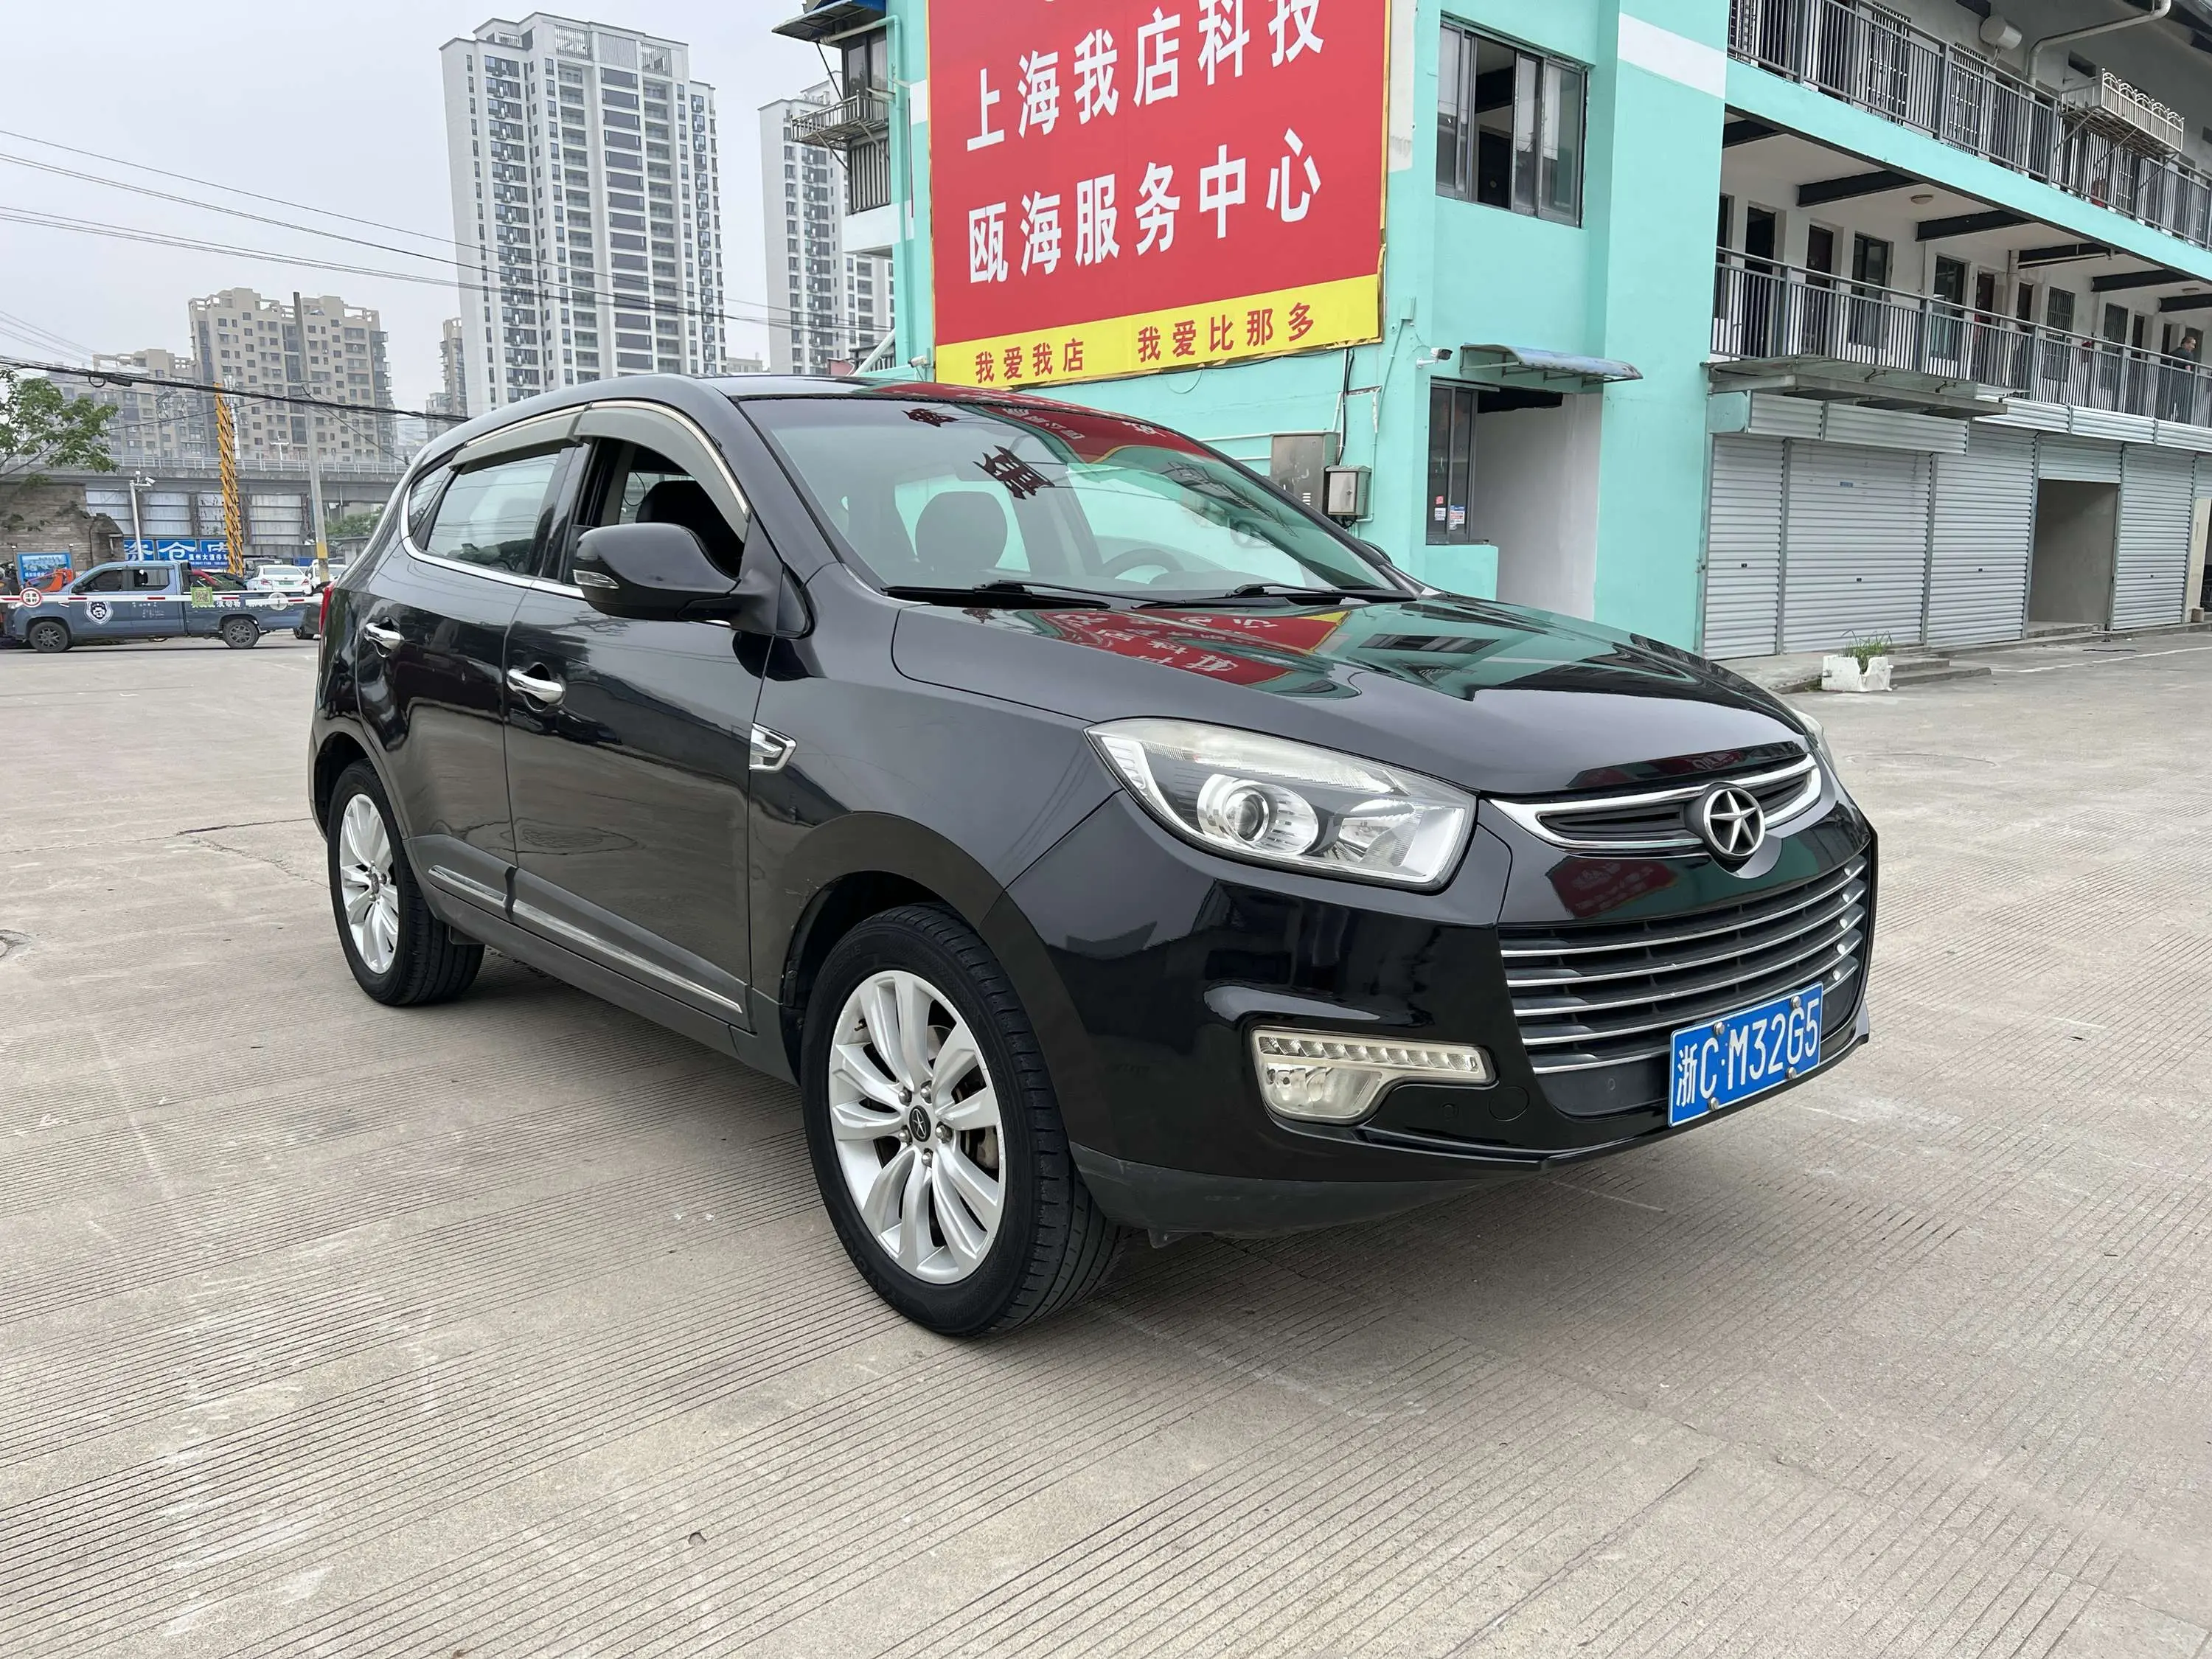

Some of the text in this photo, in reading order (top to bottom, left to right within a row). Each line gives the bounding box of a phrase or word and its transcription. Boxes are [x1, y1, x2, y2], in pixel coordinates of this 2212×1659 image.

[967, 0, 1324, 152] 上海我店科技
[968, 128, 1321, 285] 瓯海服务中心
[975, 302, 1315, 383] 我爱我店 我爱比那多
